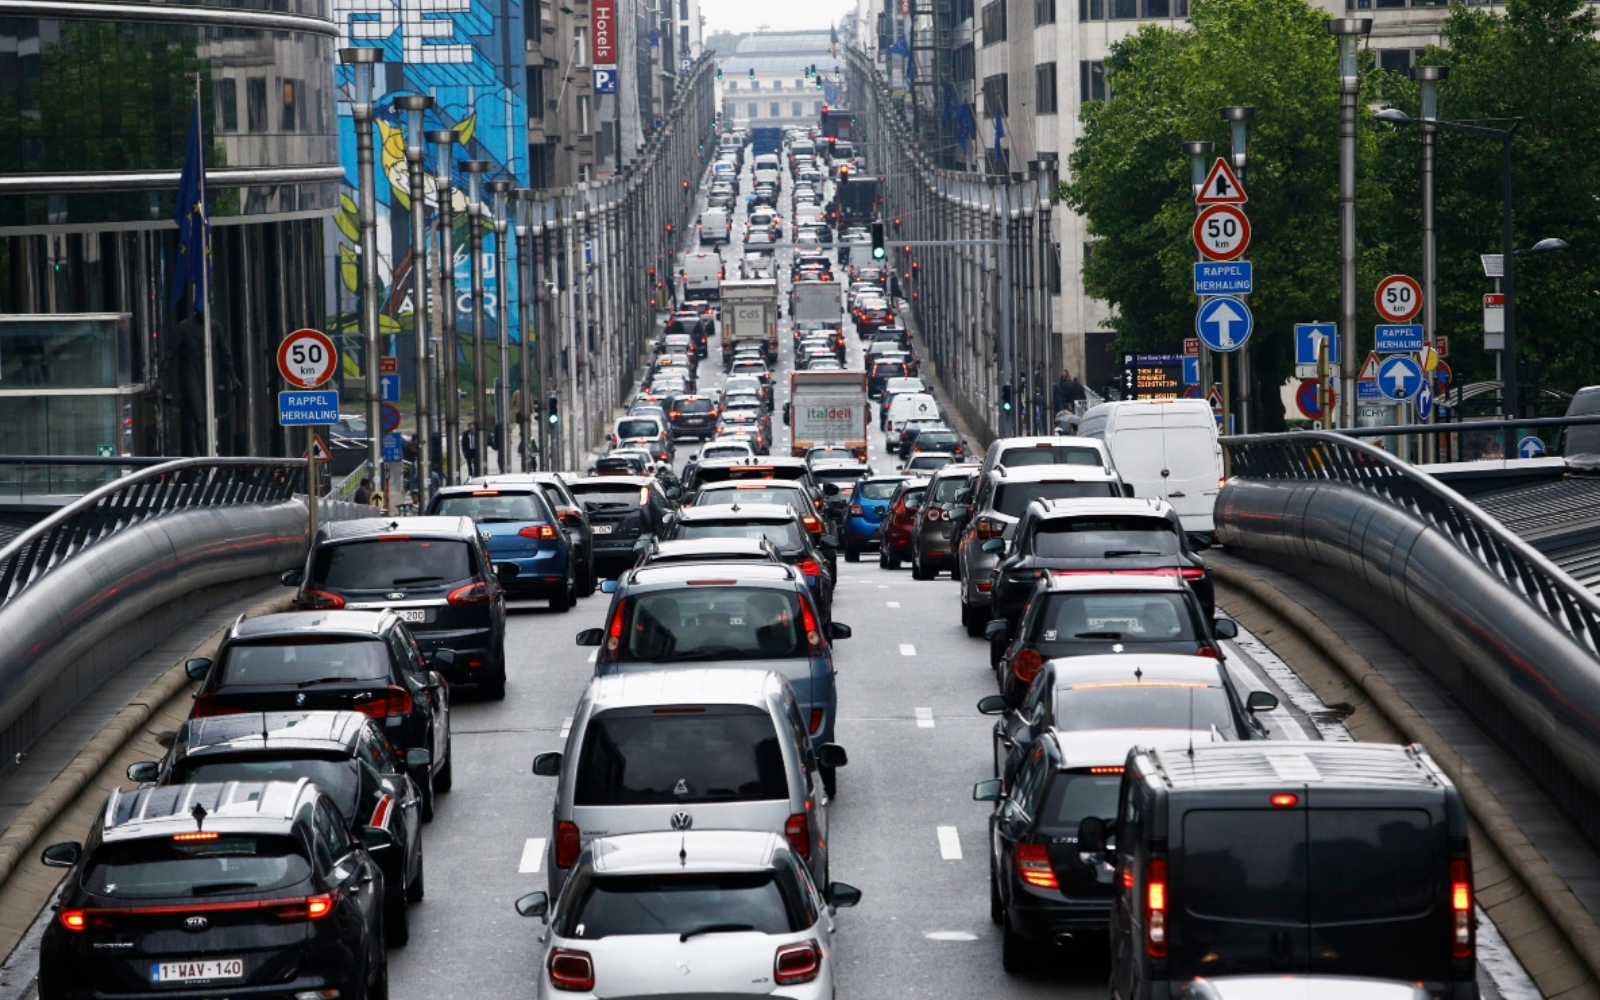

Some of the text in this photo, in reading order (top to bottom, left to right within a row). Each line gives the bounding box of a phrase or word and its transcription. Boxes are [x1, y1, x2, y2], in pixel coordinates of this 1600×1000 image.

[596, 7, 611, 57] Hotels
[596, 71, 609, 89] P
[1208, 219, 1236, 238] 50
[1215, 240, 1229, 248] km
[1203, 267, 1242, 276] RAPPEL
[1196, 280, 1250, 290] HERHALING
[1387, 287, 1411, 304] 50
[739, 309, 759, 319] CdS
[1382, 328, 1415, 337] RAPPEL
[1377, 340, 1422, 349] HERHALING
[292, 344, 322, 364] 50
[300, 366, 315, 375] km
[288, 396, 328, 406] RAPPEL
[281, 410, 337, 420] HERHALING
[807, 408, 852, 419] italdeli
[186, 917, 207, 927] KIA
